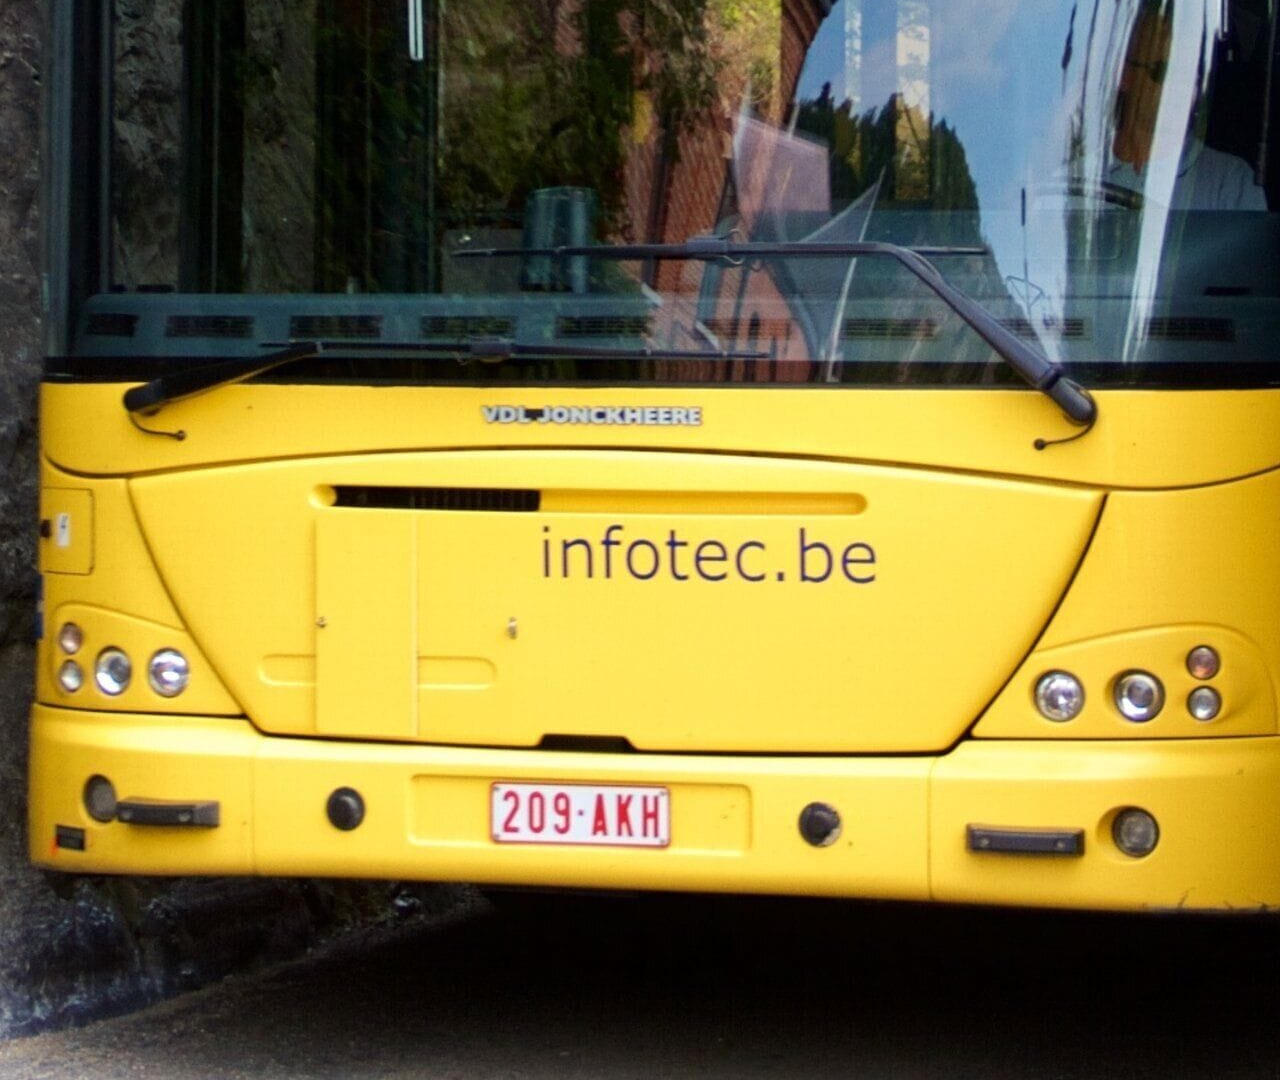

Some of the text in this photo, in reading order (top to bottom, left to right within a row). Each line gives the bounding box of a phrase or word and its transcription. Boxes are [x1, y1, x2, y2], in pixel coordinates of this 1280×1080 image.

[482, 406, 702, 426] VDL JONCKHEERE
[542, 524, 877, 584] infotec.be
